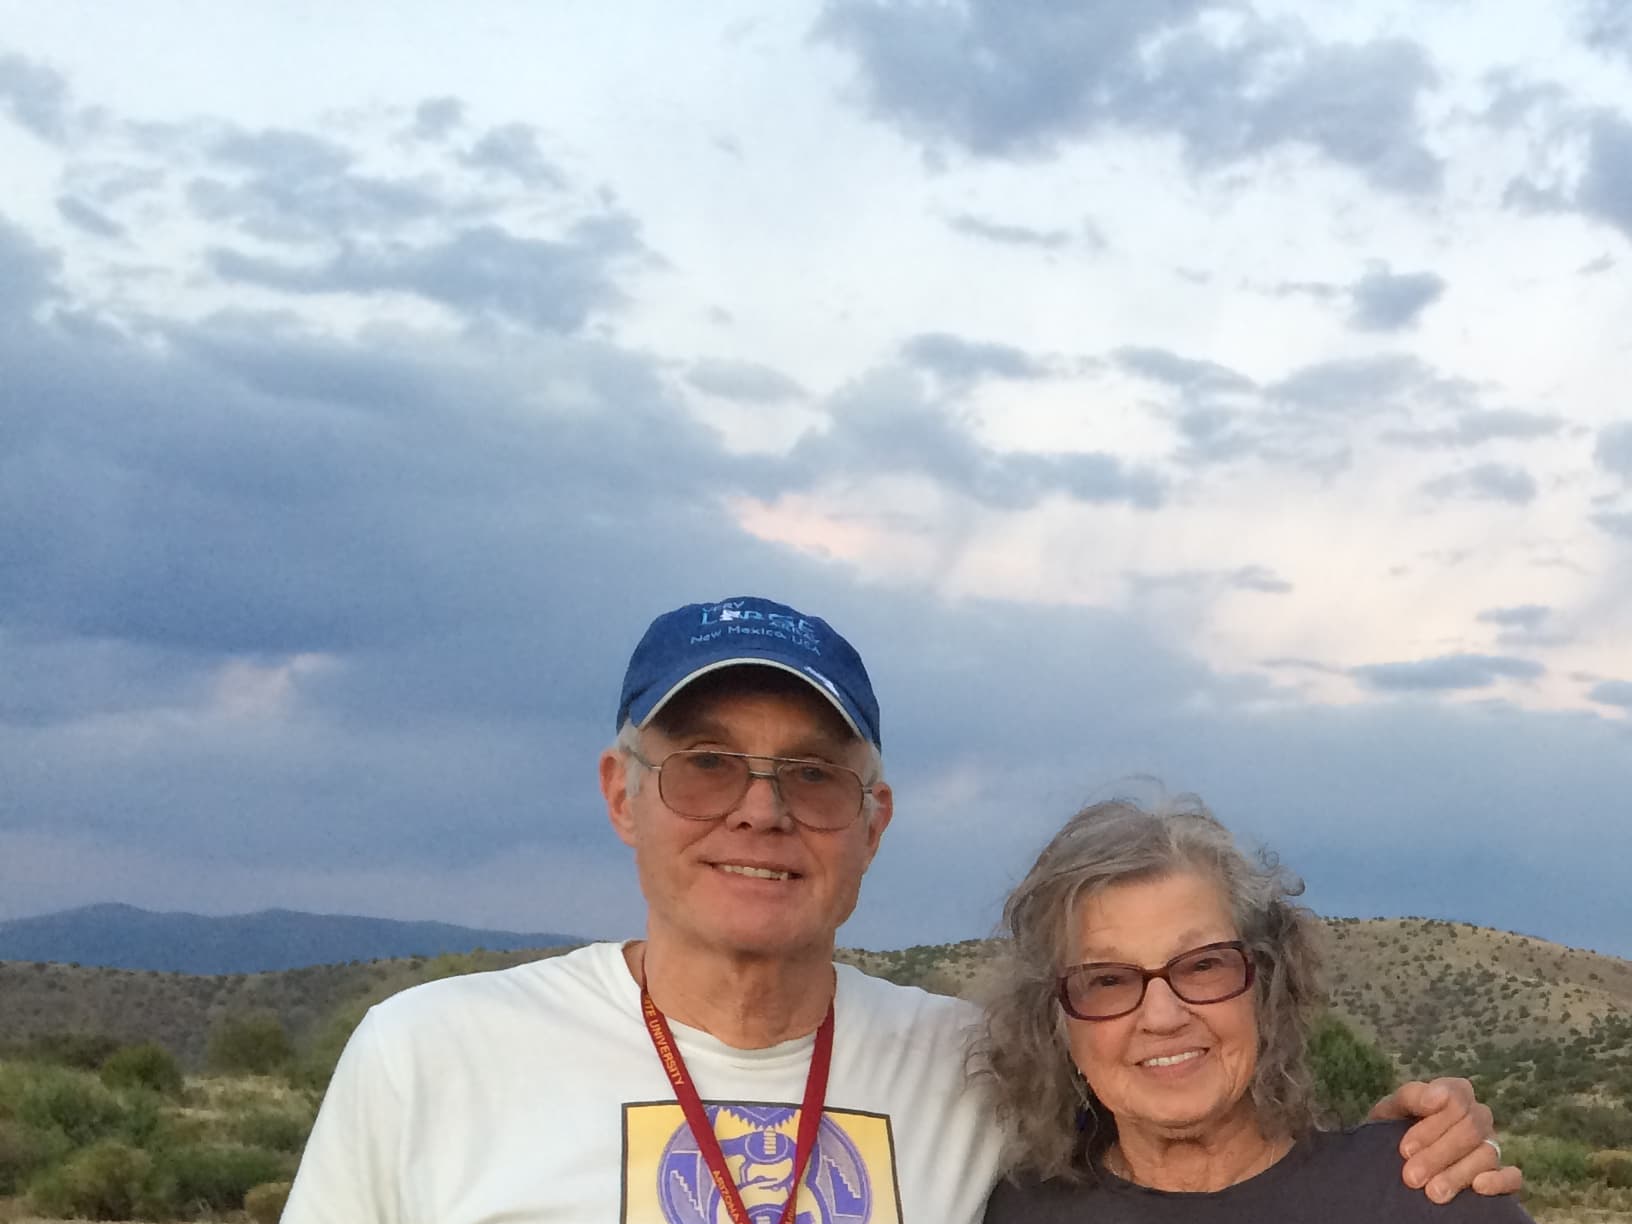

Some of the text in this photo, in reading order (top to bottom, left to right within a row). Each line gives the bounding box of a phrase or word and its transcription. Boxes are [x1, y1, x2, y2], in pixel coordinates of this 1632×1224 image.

[690, 630, 722, 645] New
[728, 625, 786, 640] Mexico
[649, 1019, 685, 1085] UNIVERSITY
